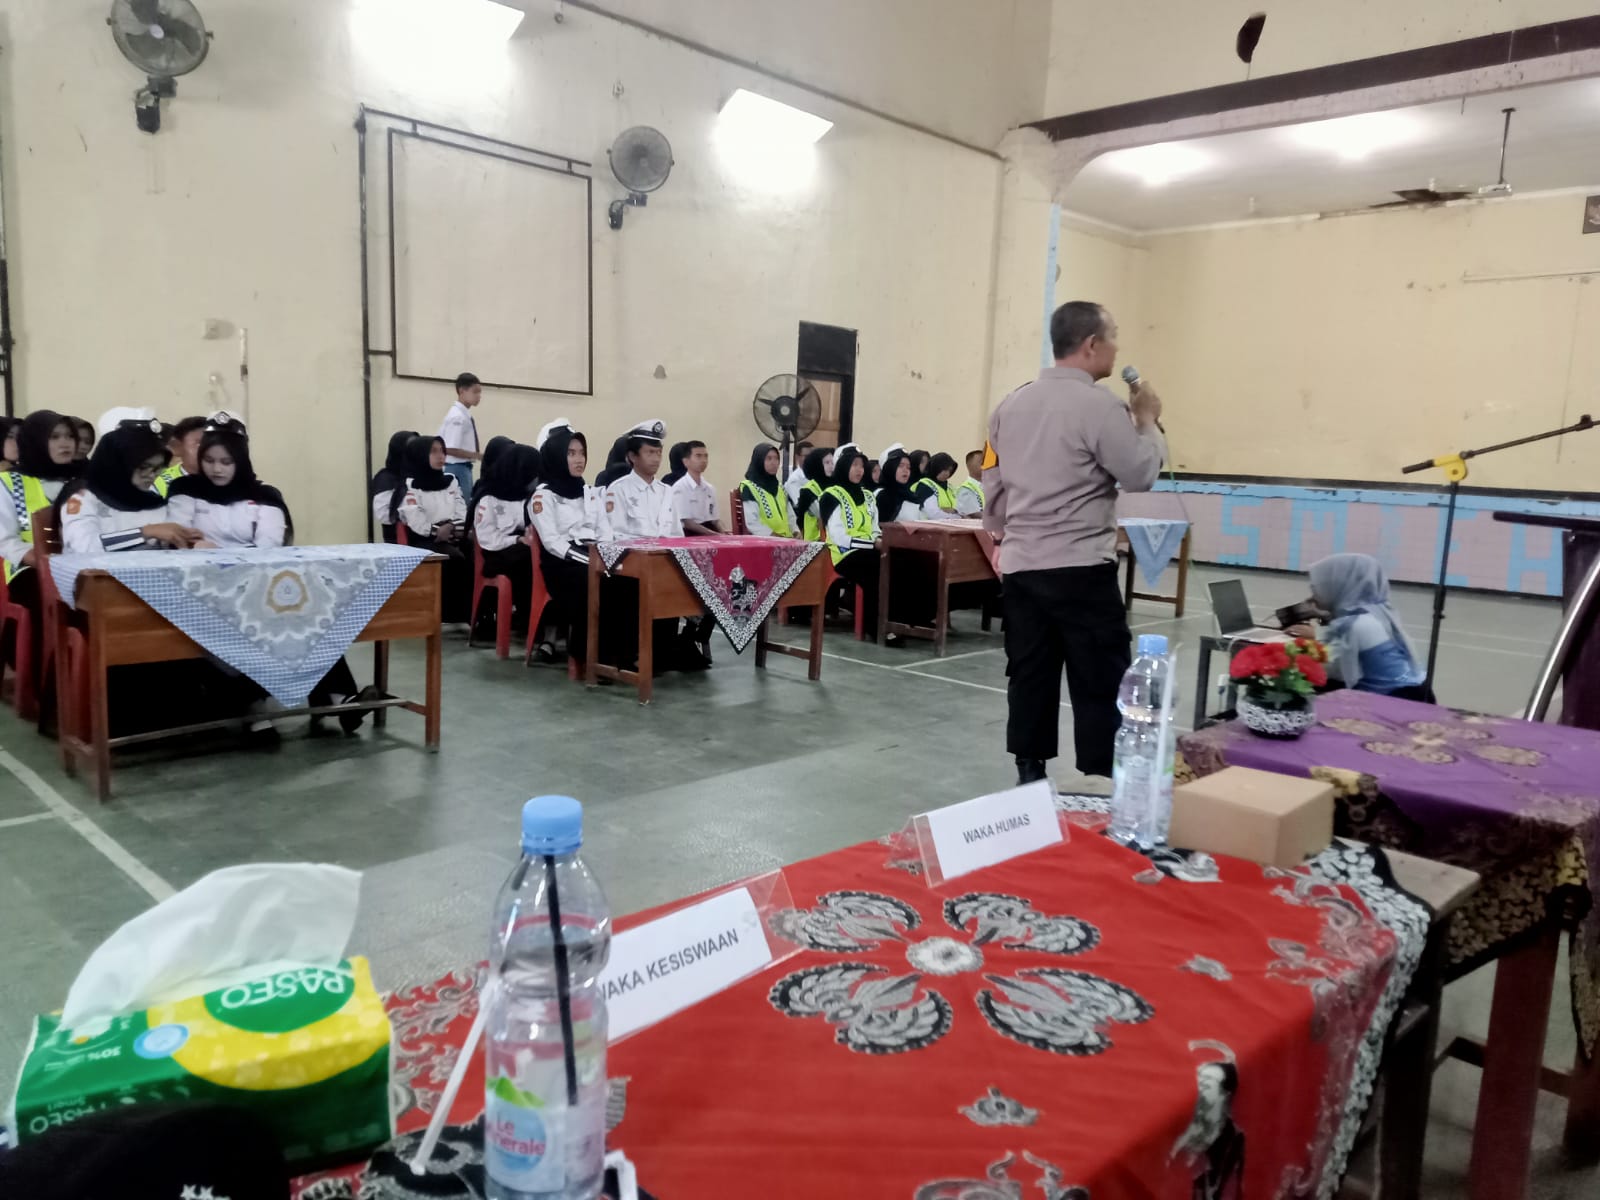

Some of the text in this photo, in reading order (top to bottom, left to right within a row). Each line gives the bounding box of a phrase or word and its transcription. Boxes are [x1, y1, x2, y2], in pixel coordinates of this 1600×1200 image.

[962, 812, 1031, 844] WAKA HUMAS
[645, 927, 740, 981] KESISWAAN
[220, 968, 345, 1009] PASEO
[29, 1102, 107, 1134] SEO
